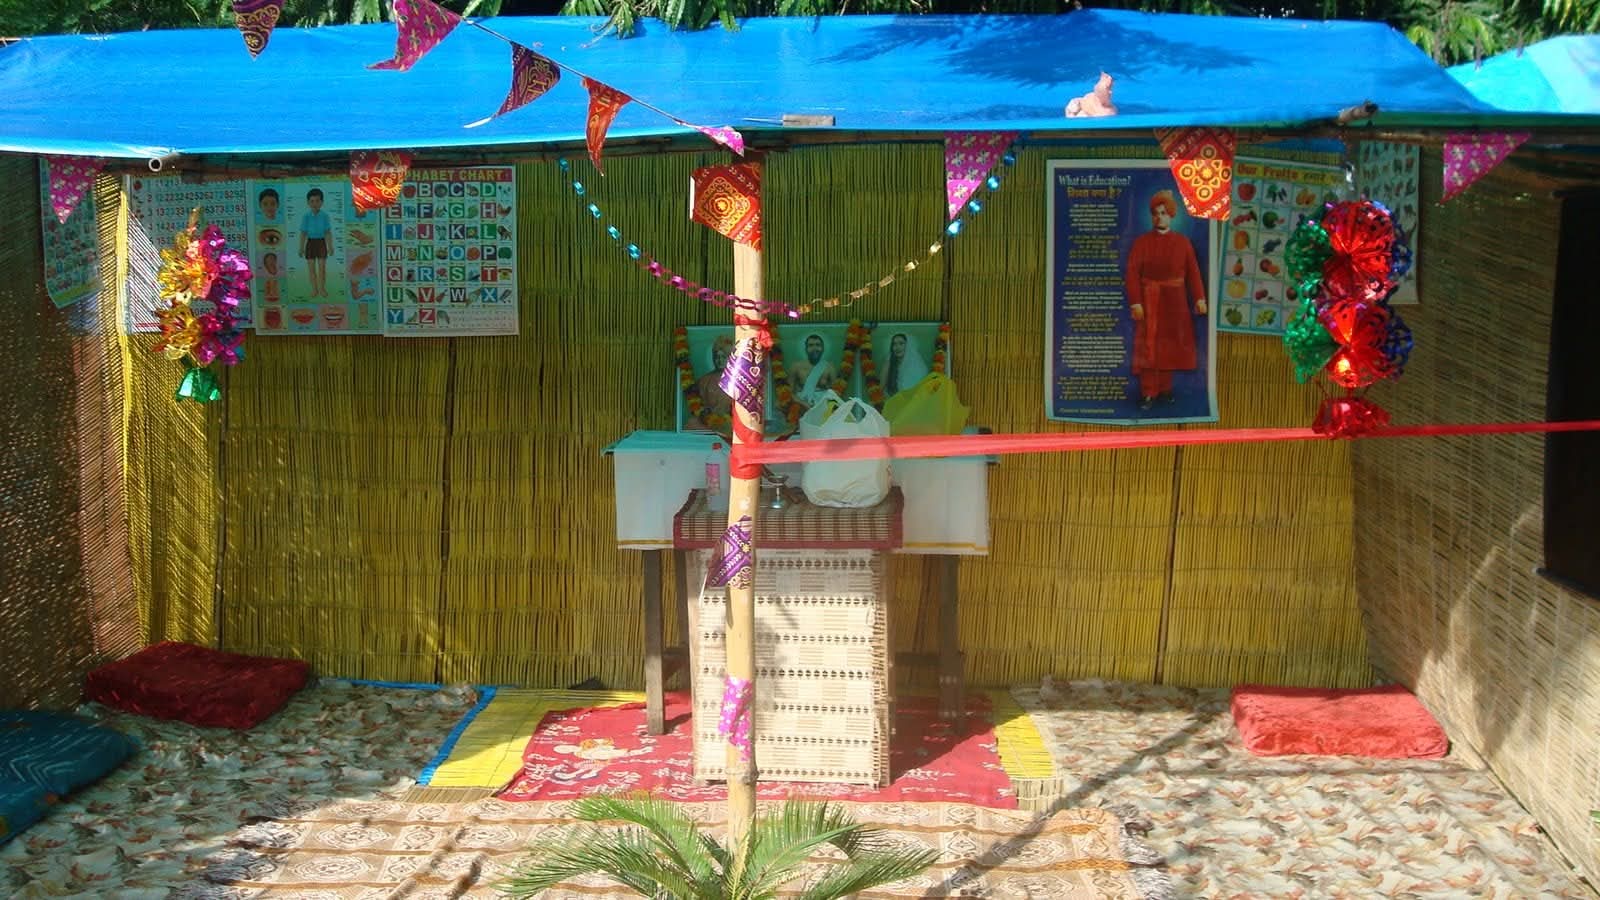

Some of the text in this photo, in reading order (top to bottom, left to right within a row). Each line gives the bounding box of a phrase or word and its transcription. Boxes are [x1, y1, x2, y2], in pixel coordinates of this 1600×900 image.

[459, 168, 504, 180] CHART
[1058, 174, 1080, 186] What
[418, 183, 496, 197] B C D
[389, 203, 495, 218] E F G H
[420, 225, 431, 239] J
[451, 225, 465, 239] K
[484, 225, 495, 239] L
[387, 246, 495, 260] M N O P
[388, 267, 496, 282] Q R S T
[389, 288, 496, 302] U V W X
[389, 309, 402, 323] Y
[421, 309, 434, 323] Z
